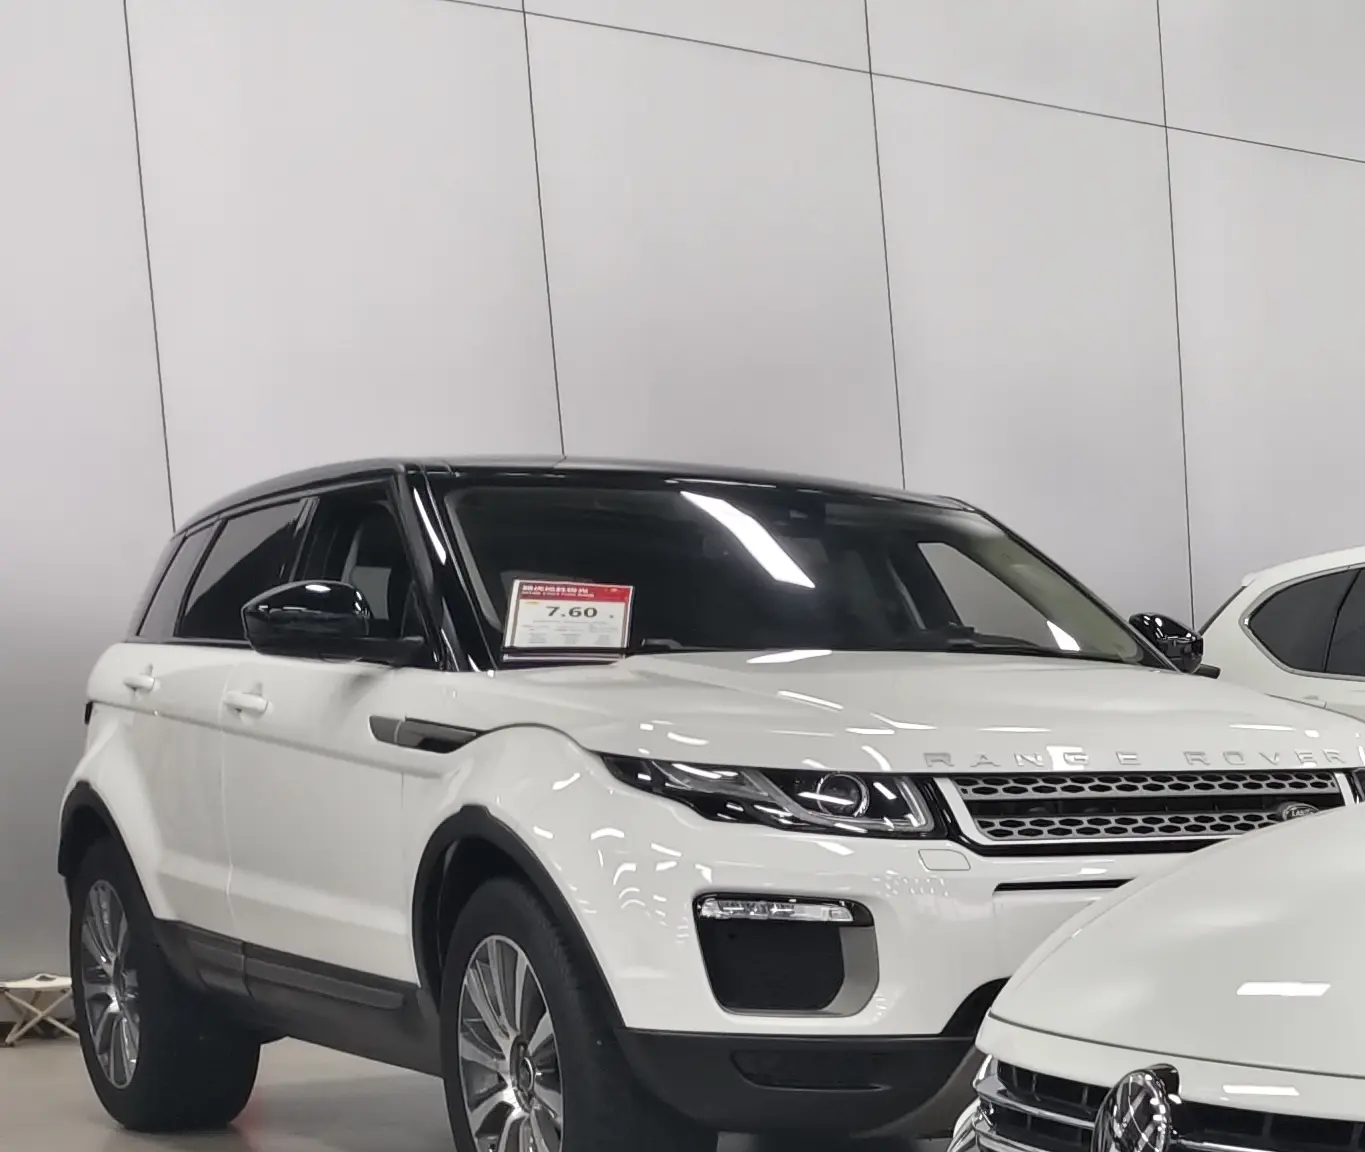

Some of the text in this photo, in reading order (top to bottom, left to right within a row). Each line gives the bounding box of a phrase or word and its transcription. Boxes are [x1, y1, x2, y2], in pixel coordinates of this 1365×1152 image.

[546, 606, 599, 619] 7.60
[922, 749, 1346, 768] RANGE ROVER
